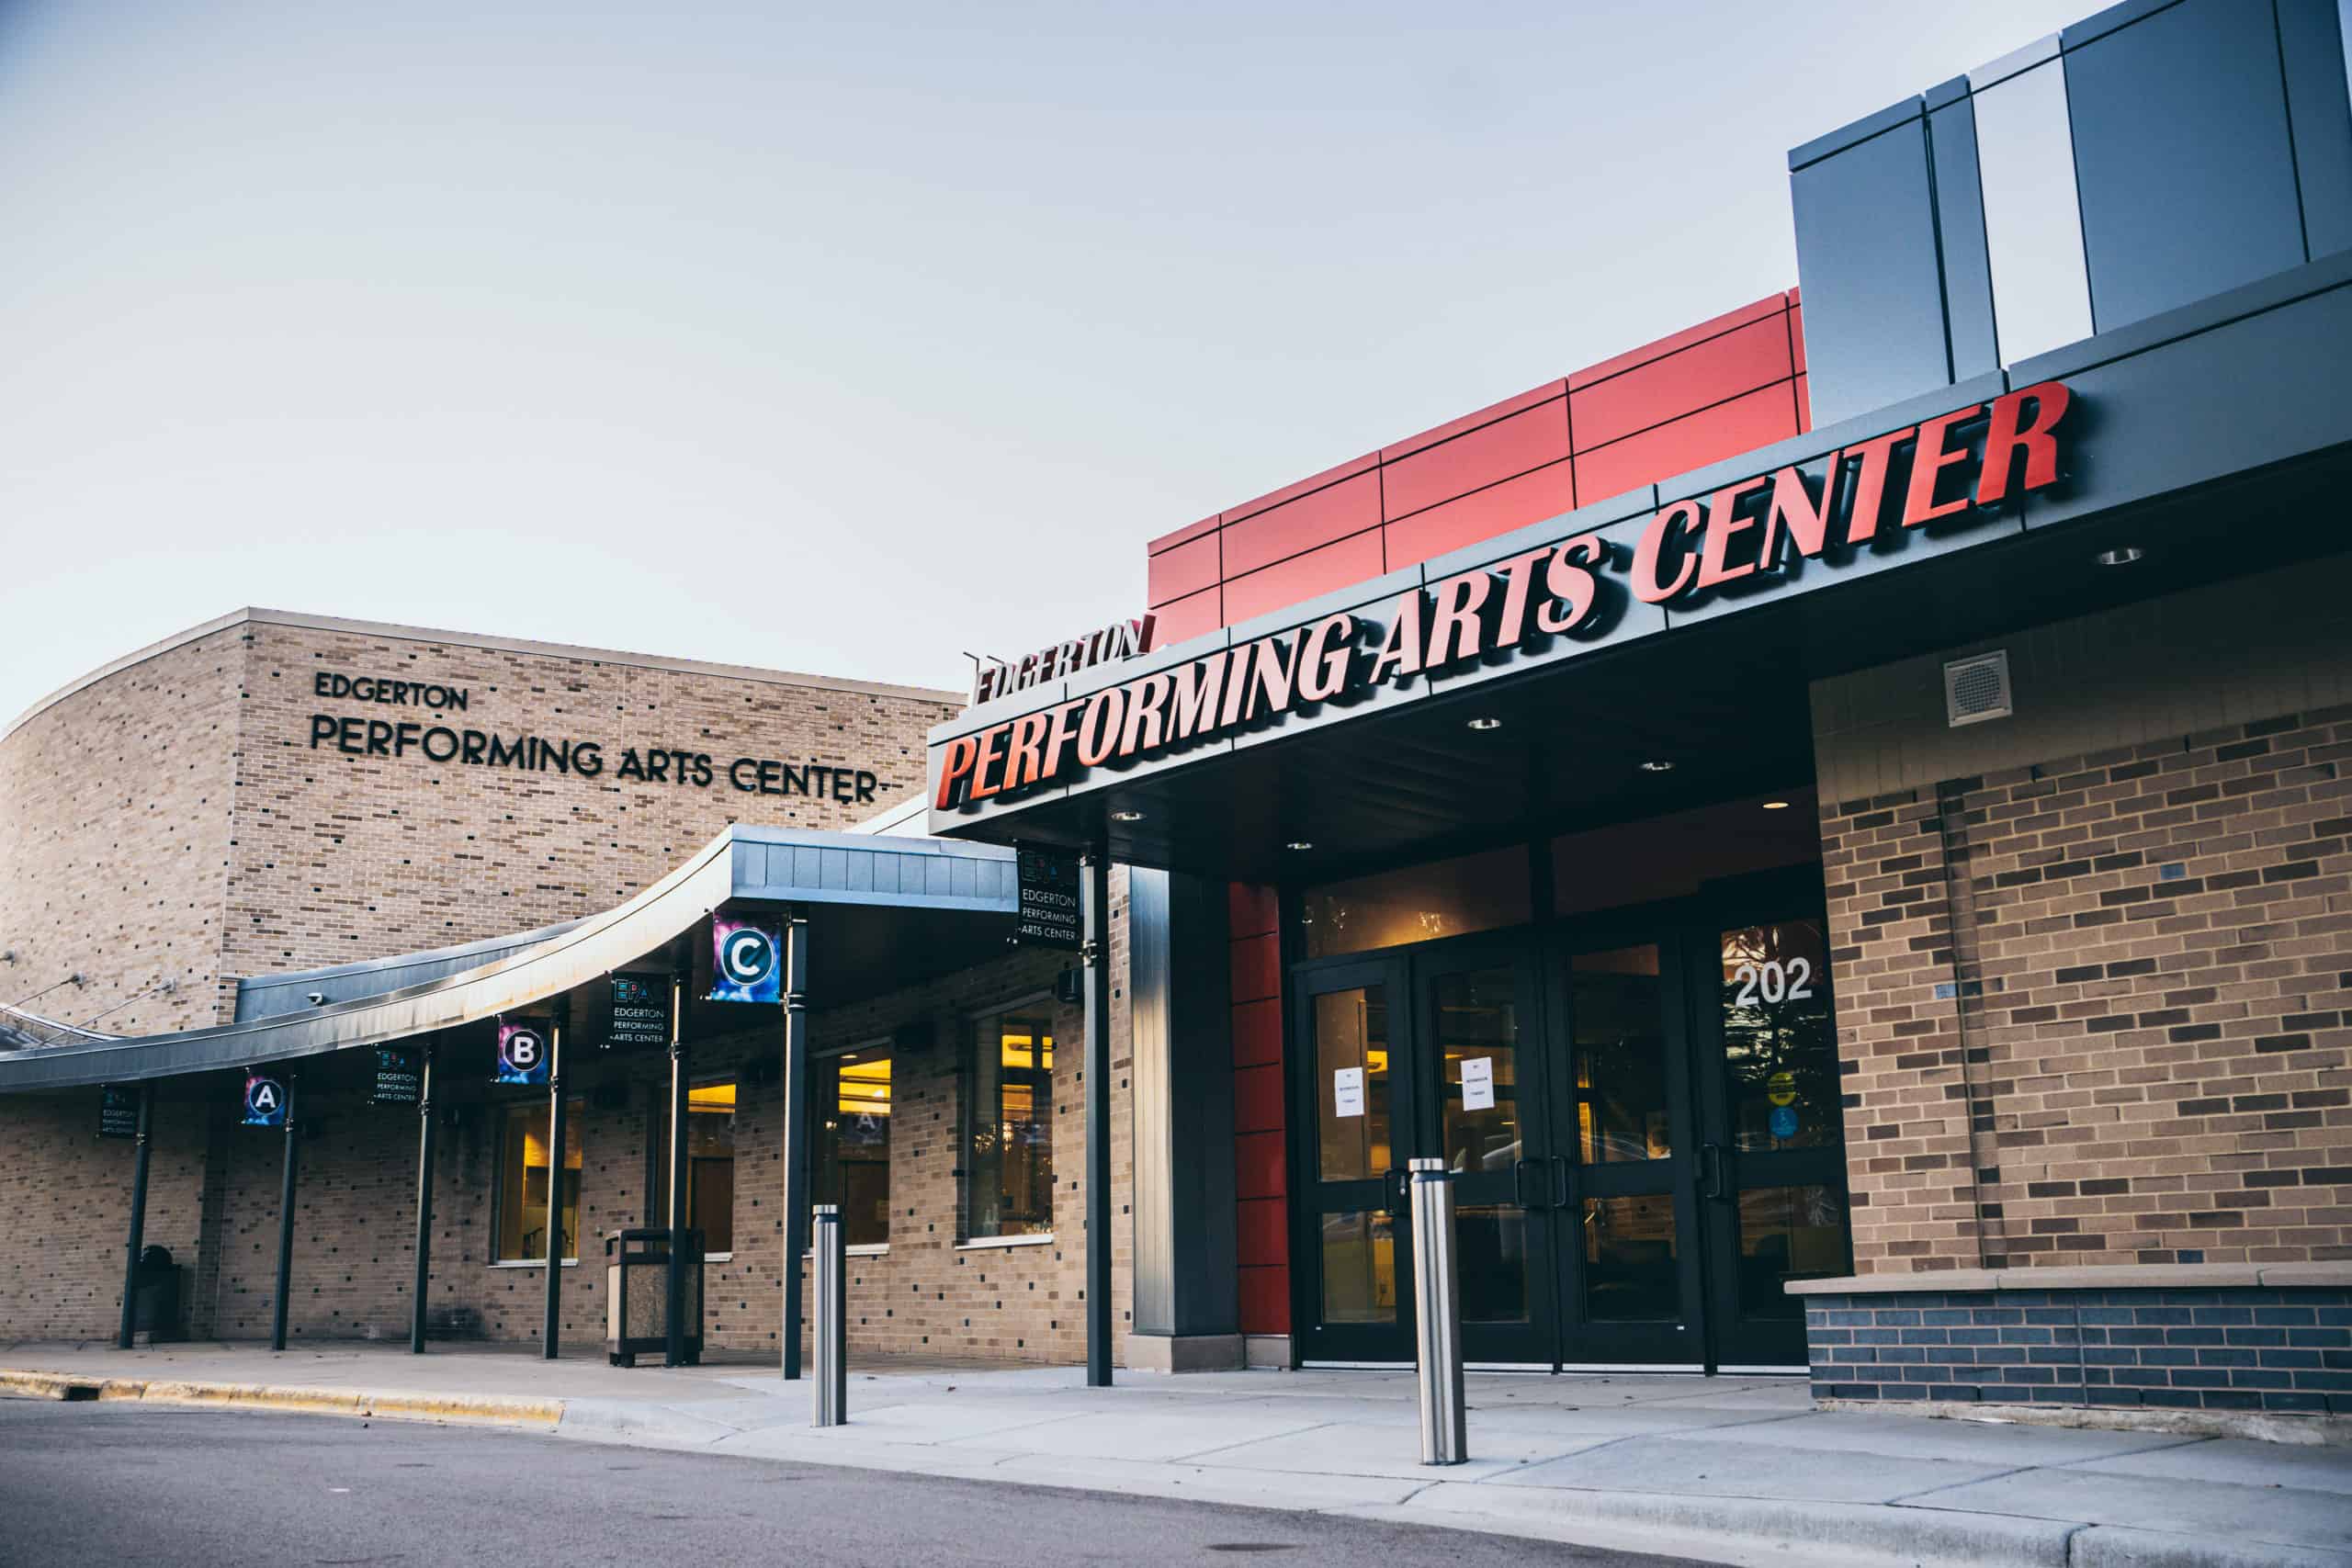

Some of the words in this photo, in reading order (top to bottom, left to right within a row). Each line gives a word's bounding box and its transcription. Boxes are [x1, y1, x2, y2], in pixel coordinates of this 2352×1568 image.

[935, 614, 1353, 810] PERFORMING
[1369, 534, 1606, 686] ARTS
[1630, 380, 2073, 604] CENTER
[972, 615, 1156, 706] EDGERTON
[314, 671, 469, 712] EDGERTON
[311, 713, 604, 779] PERFORMING
[617, 747, 714, 787] ARTS
[729, 757, 877, 804] CENTER
[1022, 888, 1077, 908] EDGERTON
[1022, 907, 1077, 924] PERFORMING
[1021, 925, 1043, 936] ARTS
[1044, 927, 1076, 941] CENTER
[730, 937, 762, 976] C
[1734, 956, 1812, 1008] 202
[614, 1007, 664, 1019] EDGERTON
[614, 1021, 663, 1031] PERFORMING
[614, 1033, 633, 1042] ARTS
[634, 1034, 663, 1043] CENTER
[514, 1036, 536, 1064] B
[378, 1073, 417, 1082] EDGERTON
[254, 1085, 277, 1110] A
